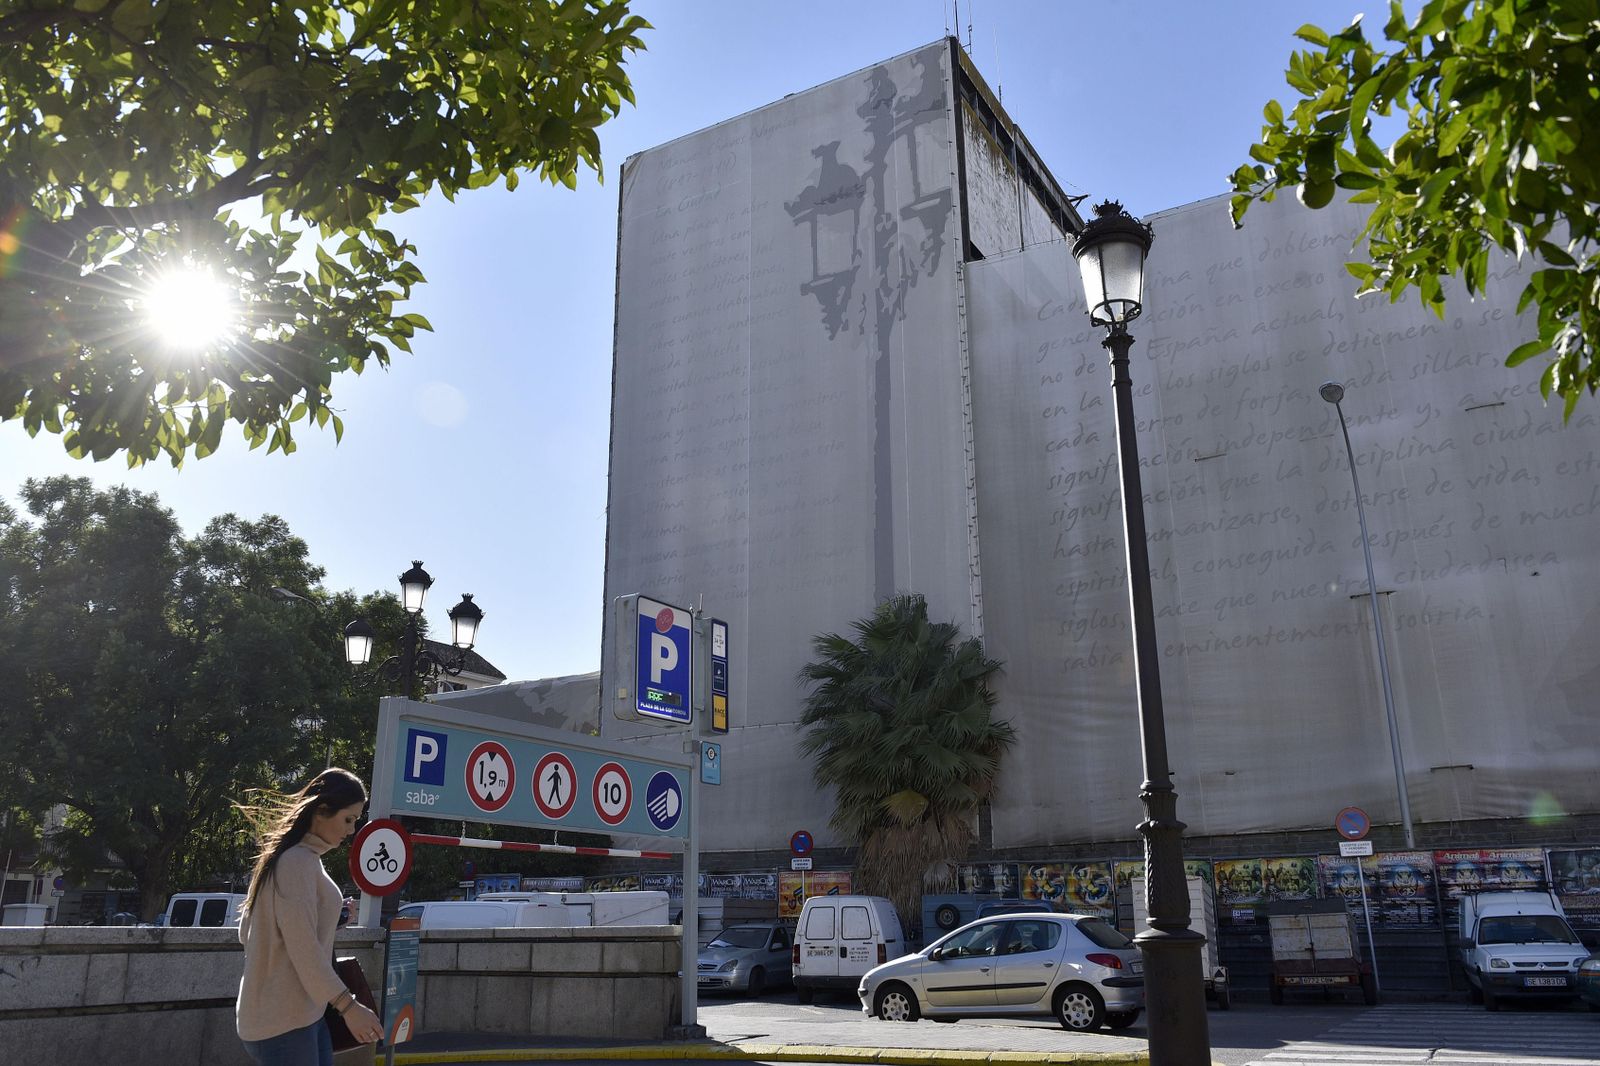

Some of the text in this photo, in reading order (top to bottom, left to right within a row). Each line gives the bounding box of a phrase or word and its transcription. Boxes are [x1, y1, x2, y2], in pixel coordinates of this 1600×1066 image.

[1038, 290, 1087, 321] Cad
[1205, 254, 1244, 285] que
[1258, 228, 1358, 263] doblemo
[1216, 291, 1243, 308] en
[1253, 271, 1325, 299] exceso
[1040, 373, 1064, 387] no
[1075, 353, 1097, 376] de
[1146, 328, 1239, 365] España
[1251, 297, 1345, 336] actual,
[1042, 406, 1068, 419] en
[1079, 391, 1104, 412] la
[1166, 369, 1194, 390] los
[1206, 353, 1273, 389] siglos
[1284, 349, 1308, 368] se
[1321, 322, 1439, 357] detienen
[1453, 317, 1464, 331] o
[1478, 306, 1505, 327] se
[1045, 421, 1101, 453] cada
[1196, 393, 1225, 421] de
[1233, 385, 1312, 422] forja,
[1343, 359, 1395, 391] ada
[1408, 347, 1500, 382] sillar,
[1047, 436, 1201, 496] signifiación
[1457, 392, 1478, 408] a
[1049, 473, 1206, 532] signifiación
[1218, 472, 1262, 502] que
[1276, 459, 1304, 482] la
[1317, 435, 1457, 478] disciplina
[1052, 450, 1600, 560] hasta umanizarse, dotarse de vida, est
[1055, 557, 1179, 605] espirital,
[1192, 527, 1338, 577] conseguida
[1470, 501, 1504, 532] de
[1058, 607, 1126, 642] siglos,
[1154, 599, 1201, 619] ace
[1214, 590, 1258, 622] que
[1393, 543, 1494, 584] ciudad
[650, 632, 679, 684] P
[1393, 594, 1496, 632] sobria.
[413, 735, 438, 778] P
[479, 760, 506, 788] 1,9 m
[603, 782, 622, 804] 10
